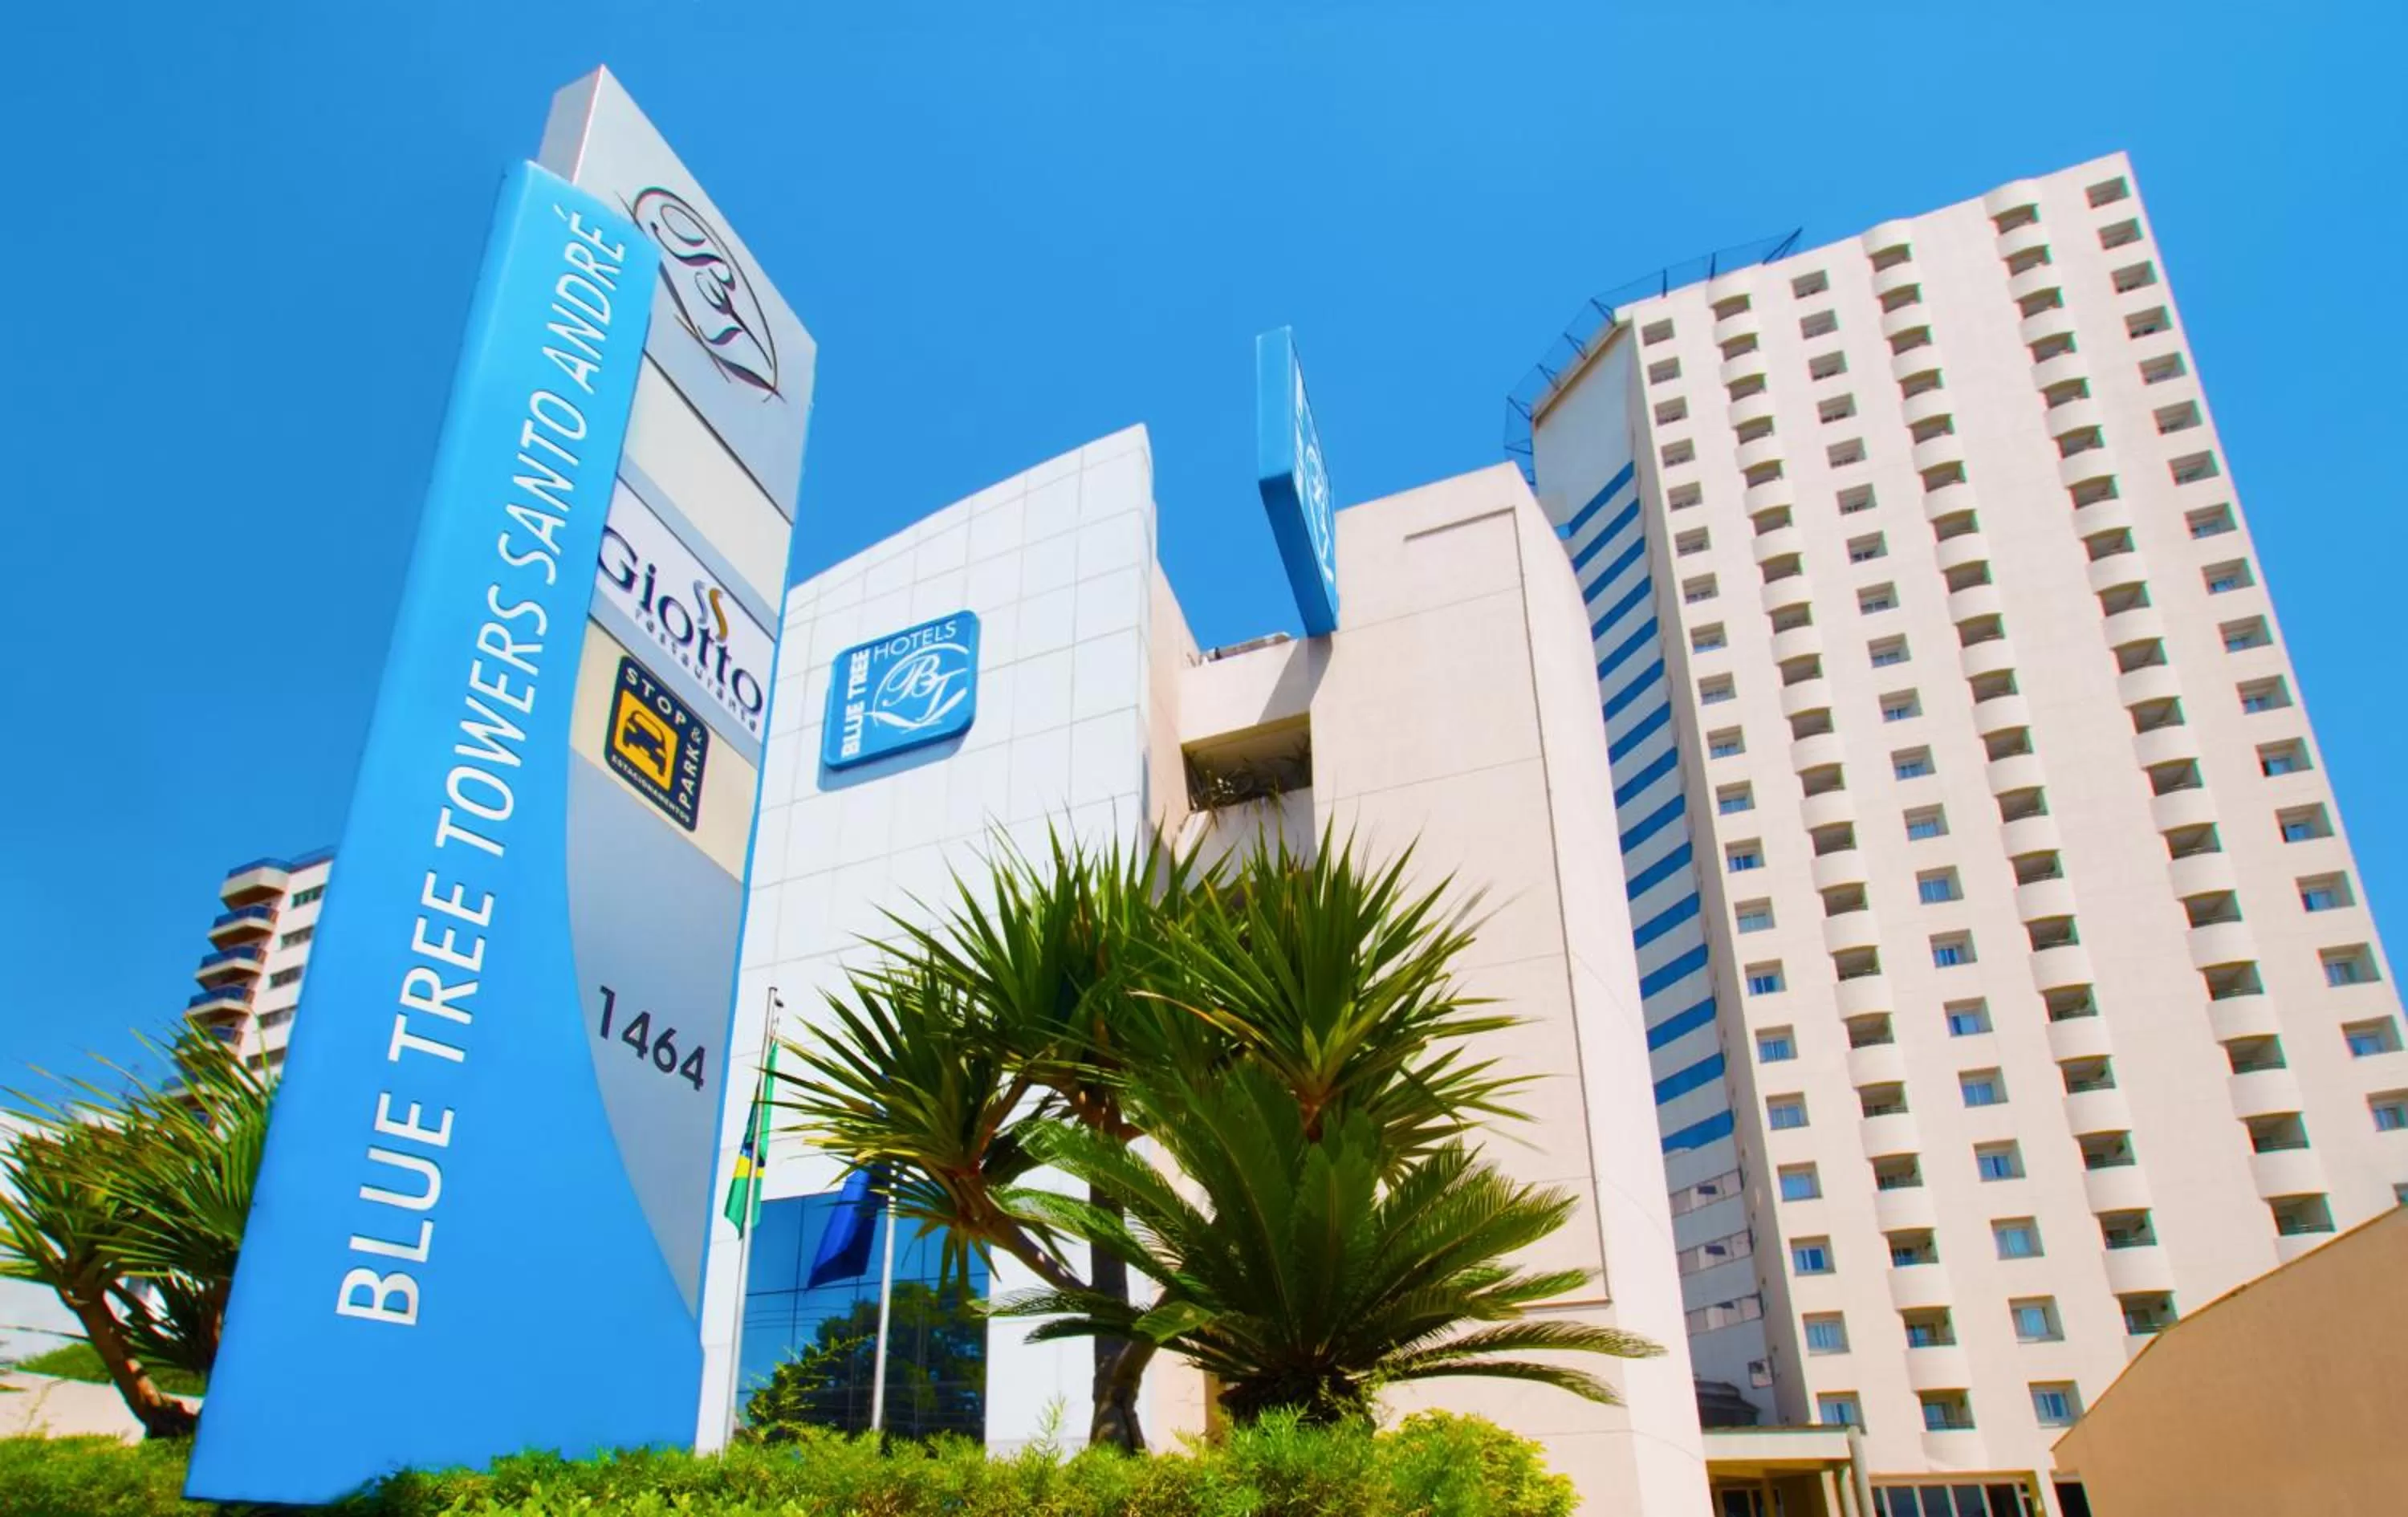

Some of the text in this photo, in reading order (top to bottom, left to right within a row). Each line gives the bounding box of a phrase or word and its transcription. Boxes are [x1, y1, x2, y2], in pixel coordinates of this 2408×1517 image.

[597, 524, 763, 714] Giotto
[625, 667, 687, 725] STOP
[840, 620, 957, 758] BLUE TREE HOTELS
[336, 204, 625, 1325] BLUE TREE TOWERS SANTO ANDRÉ
[611, 754, 690, 823] ESTACIONAMENTOS
[678, 742, 700, 810] PARK
[600, 986, 706, 1091] 1464
